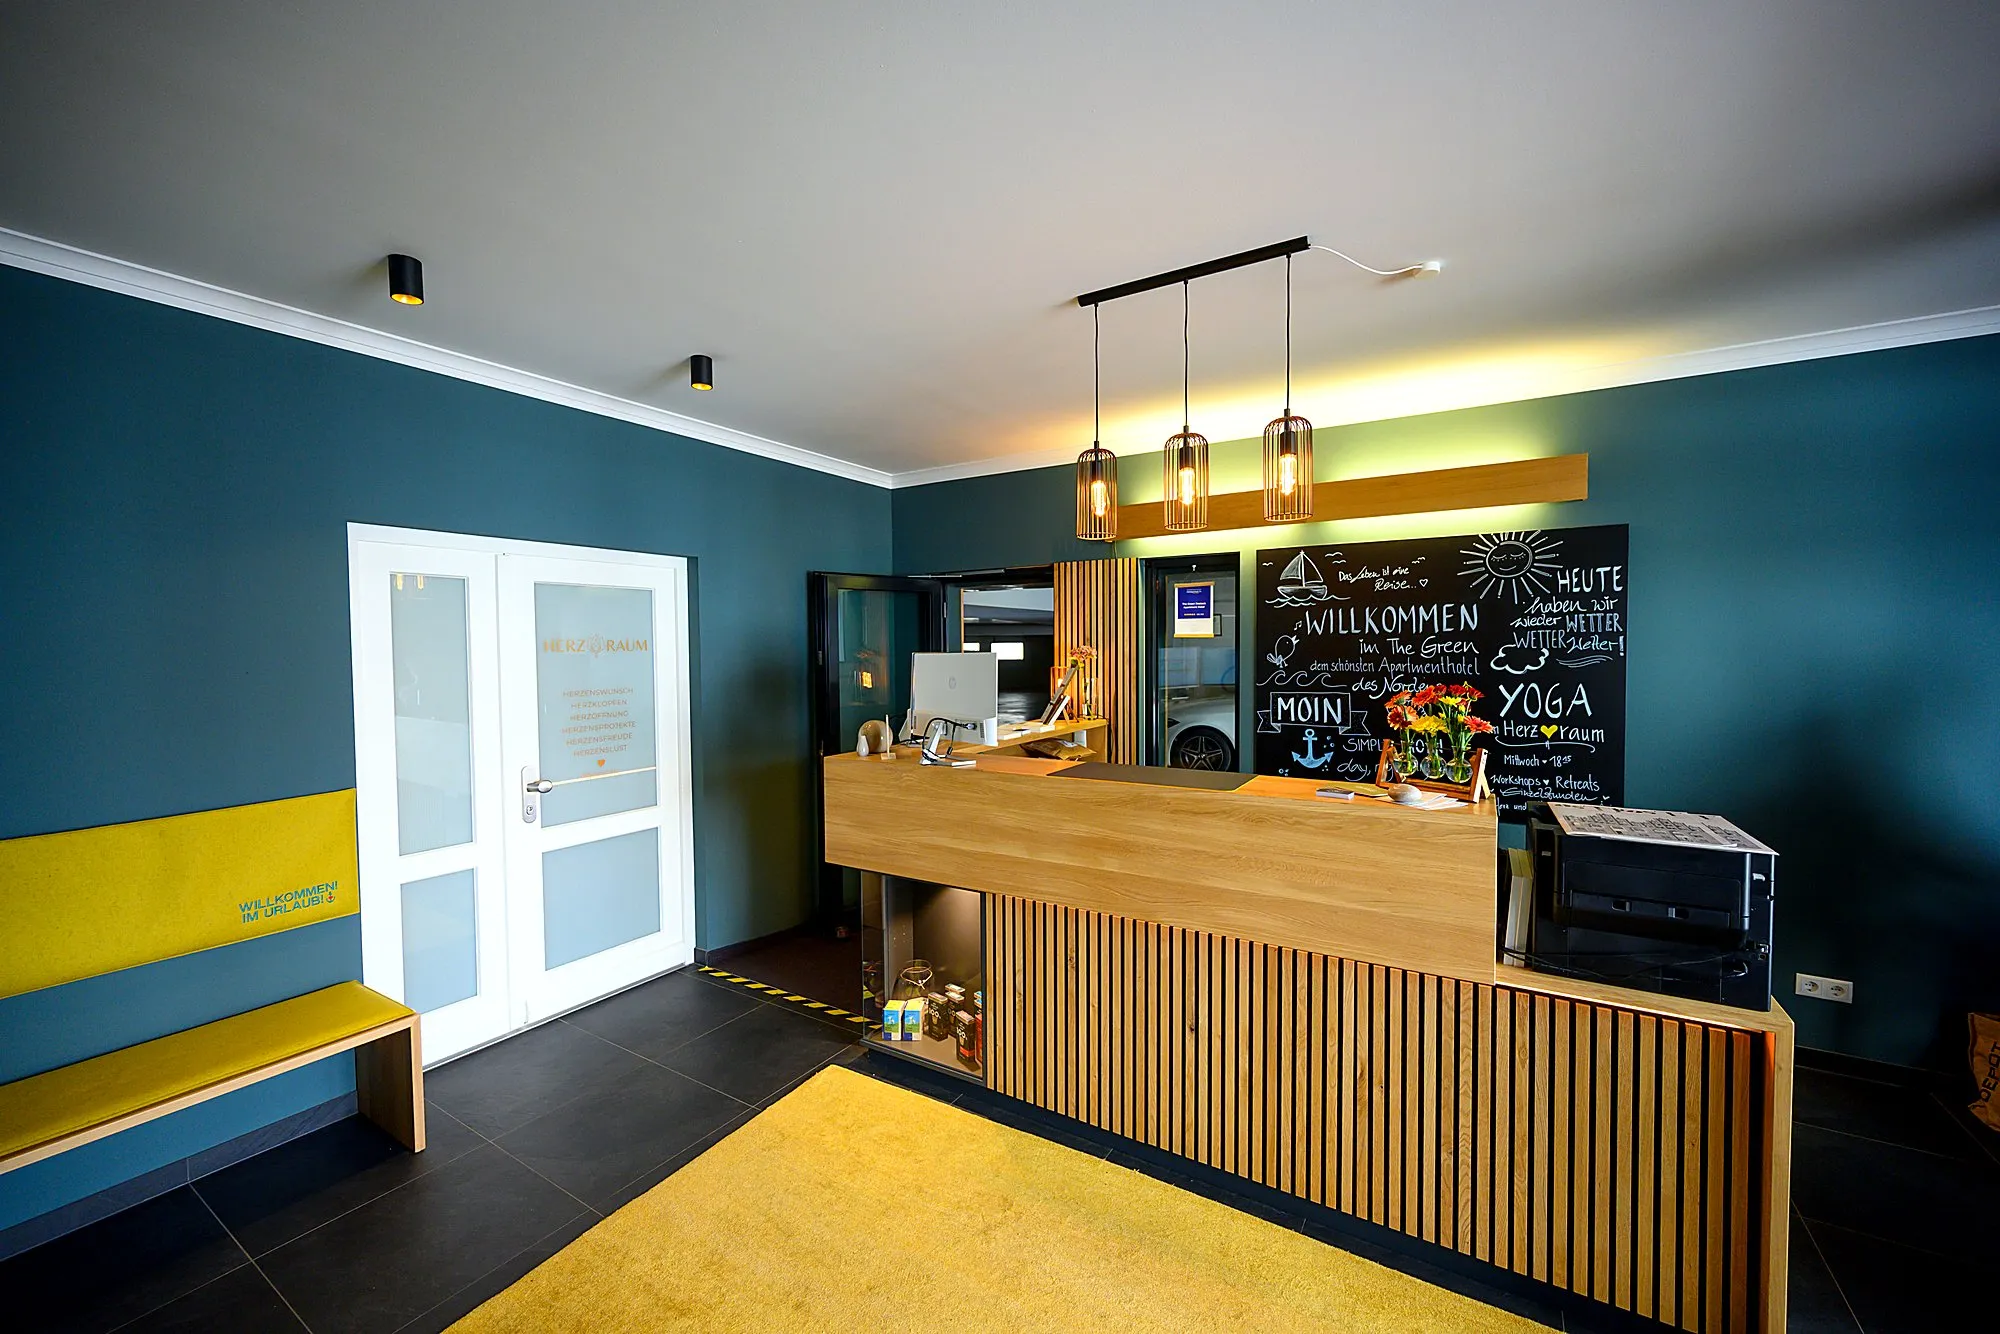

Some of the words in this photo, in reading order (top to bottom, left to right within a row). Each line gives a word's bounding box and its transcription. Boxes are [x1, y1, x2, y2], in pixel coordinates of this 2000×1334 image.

[1337, 570, 1353, 583] Das
[1382, 566, 1390, 577] ist
[1557, 565, 1623, 594] HEUTE
[1524, 596, 1587, 614] haben
[1590, 594, 1620, 611] wir
[1305, 603, 1478, 635] WILLKOMMEN
[1508, 613, 1563, 629] wieder
[1564, 612, 1624, 634] WETTER
[543, 639, 586, 653] HERZ
[606, 639, 648, 652] RAUM
[1357, 638, 1380, 655] im
[1386, 636, 1416, 655] The
[1420, 635, 1481, 659] Green
[1512, 629, 1568, 650] WETTER
[1309, 659, 1330, 672] dem
[1330, 656, 1375, 673] schönsten
[1377, 655, 1481, 679] Apartmenthotel
[1351, 676, 1379, 692] des
[1276, 694, 1343, 725] MOIN
[1498, 682, 1593, 719] YOGA
[1503, 720, 1539, 738] Herz
[1559, 726, 1606, 743] raum
[1342, 738, 1384, 752] SIMPL
[1503, 754, 1540, 767] Mittwoch
[1490, 773, 1542, 790] Workshops
[1555, 773, 1600, 792] Retreats
[1499, 786, 1598, 802] Einzelstunden
[238, 880, 338, 913] WILLKOMMEN!
[242, 911, 259, 923] IM
[263, 895, 324, 918] URLAUB!
